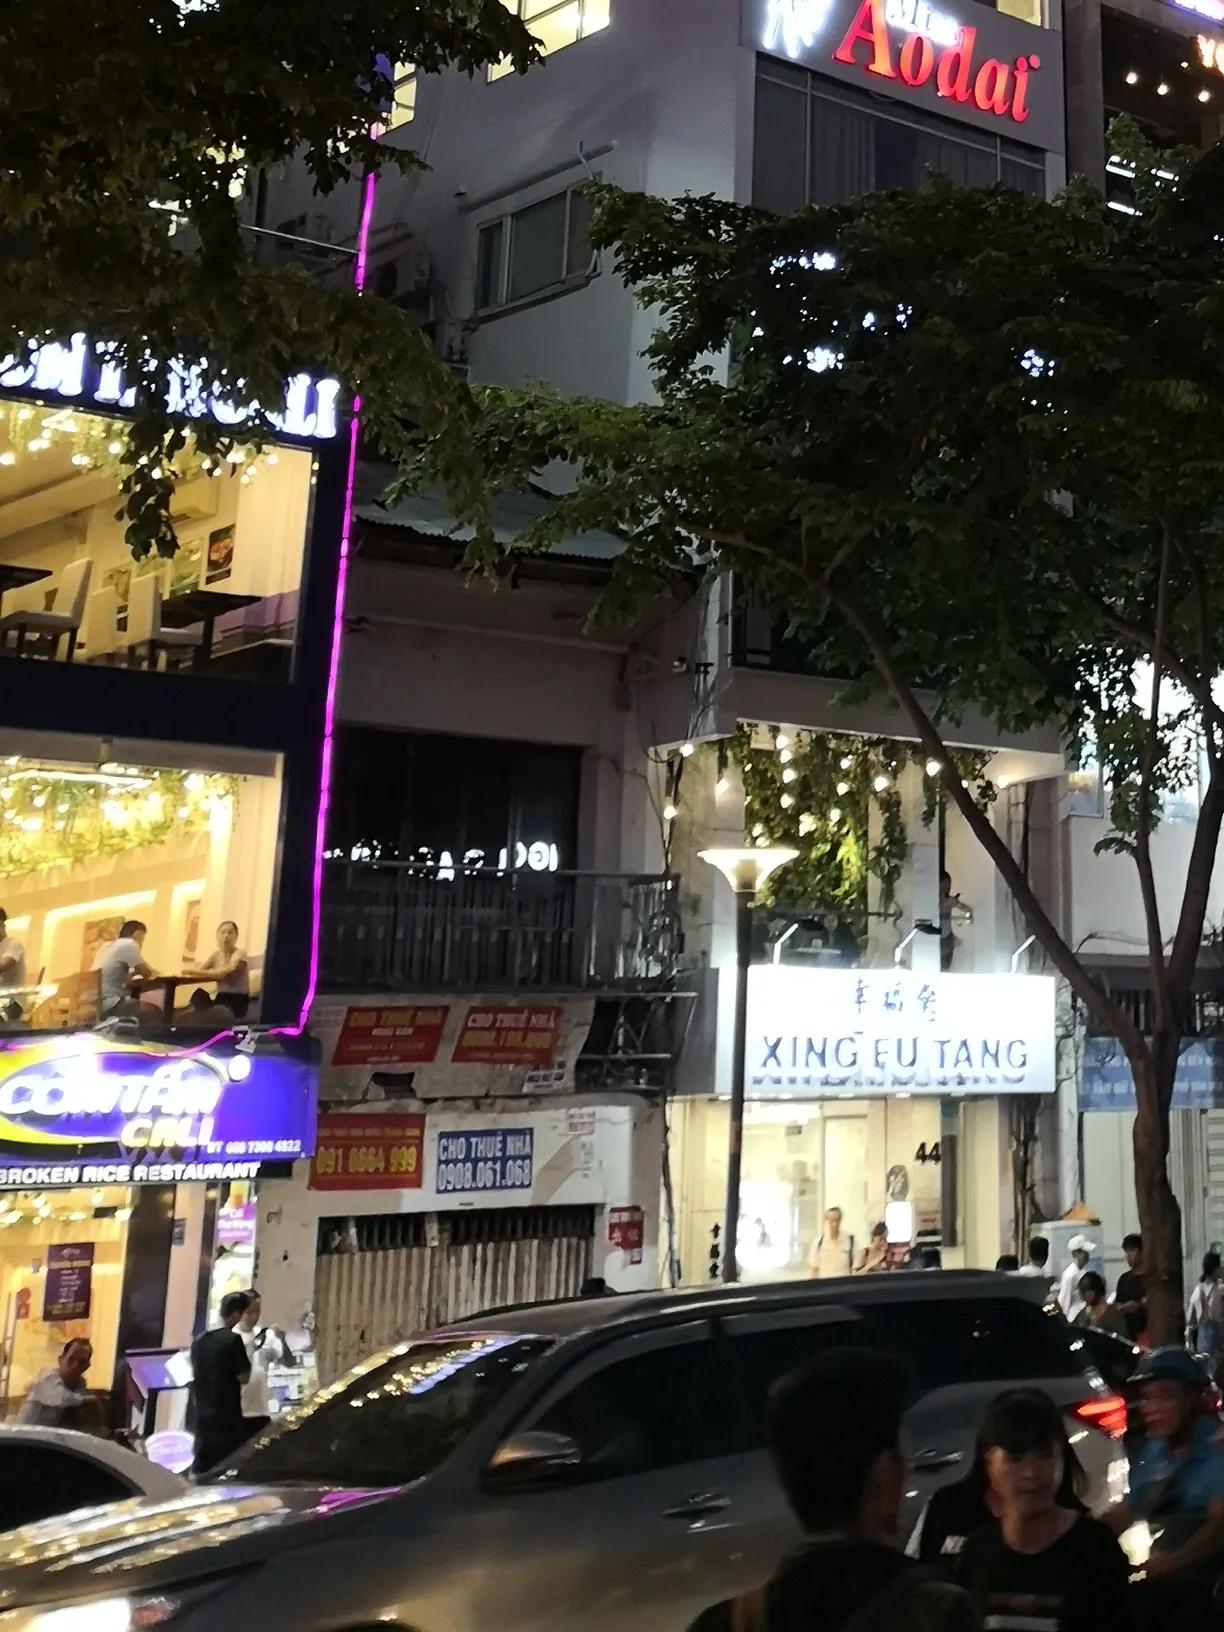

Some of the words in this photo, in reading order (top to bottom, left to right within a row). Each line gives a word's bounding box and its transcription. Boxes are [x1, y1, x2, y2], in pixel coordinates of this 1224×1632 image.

[761, 1035, 858, 1068] XING
[933, 1039, 1027, 1068] TANG
[440, 1137, 466, 1160] CHO
[915, 1142, 941, 1165] 44
[82, 1165, 130, 1181] RICE
[133, 1162, 260, 1180] RESTAURANT
